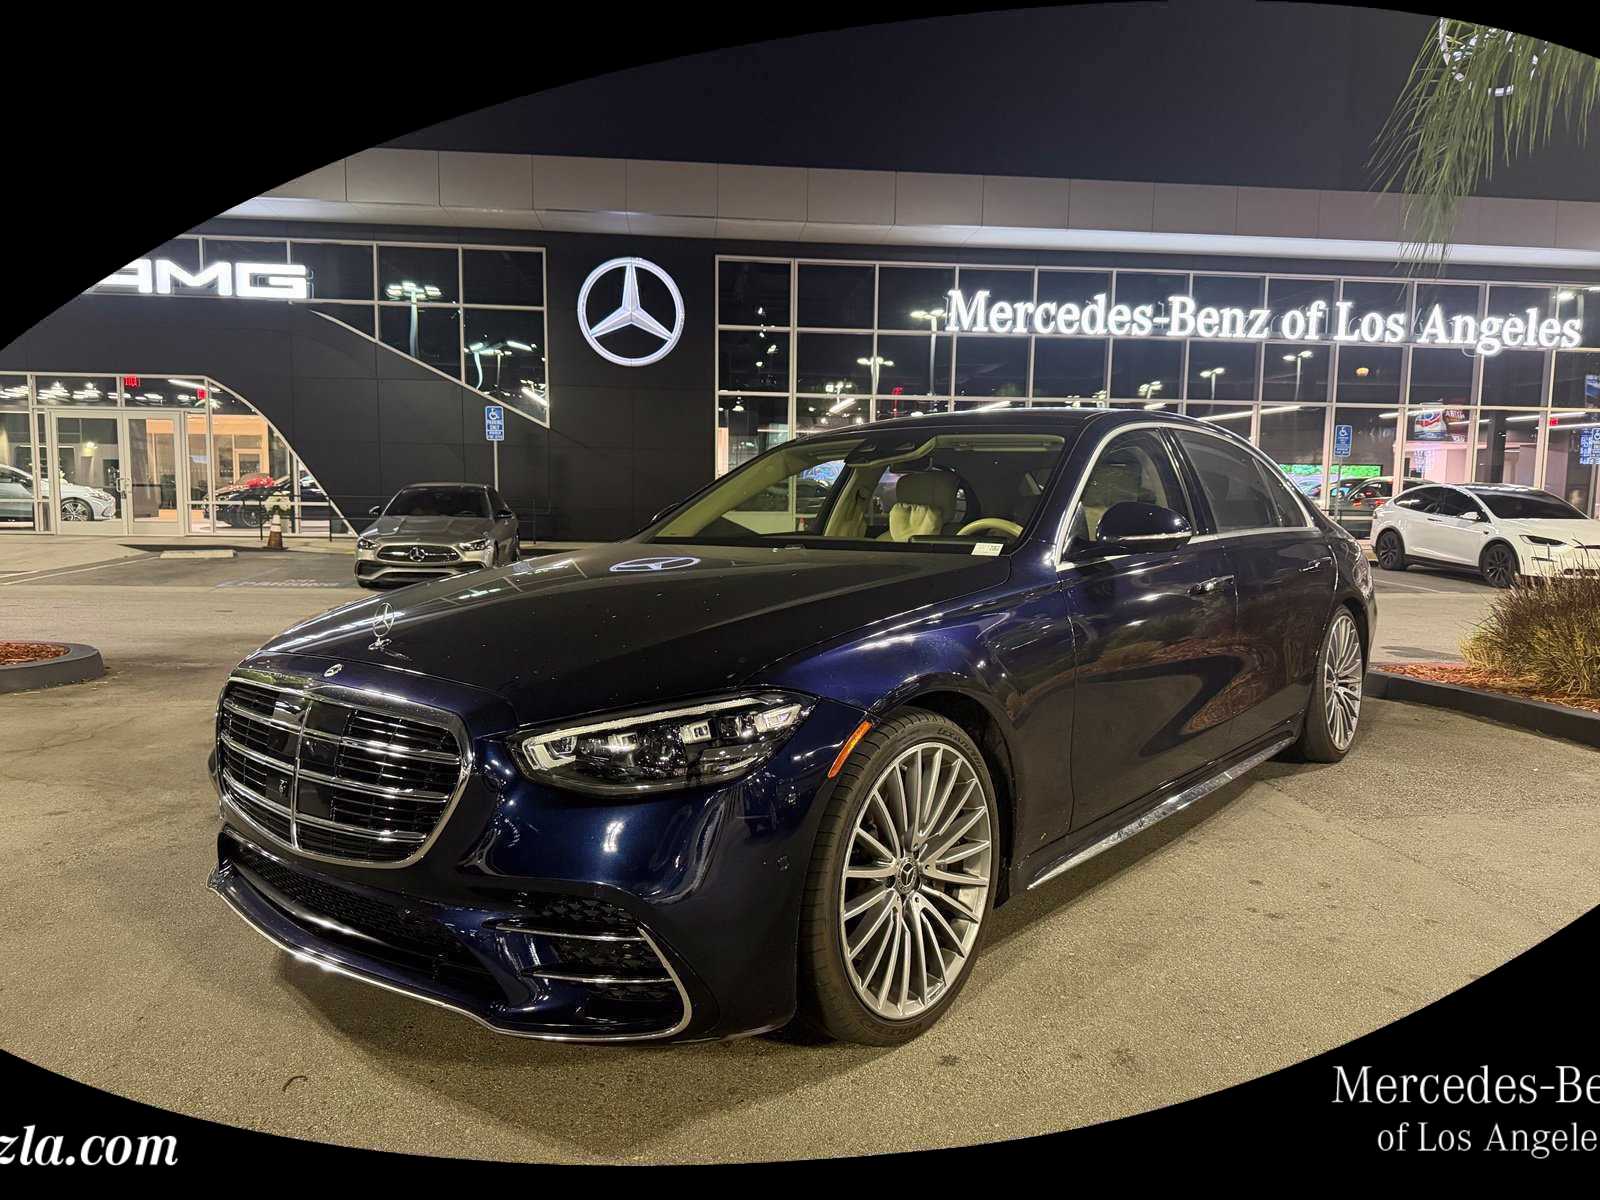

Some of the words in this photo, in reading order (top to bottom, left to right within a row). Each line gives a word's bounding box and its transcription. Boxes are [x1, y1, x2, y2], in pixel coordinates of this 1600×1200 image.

[98, 259, 308, 299] AMG
[945, 289, 1271, 338] Mercedes-Benz
[1281, 301, 1327, 340] of
[1333, 301, 1407, 343] Los
[1417, 304, 1584, 356] Angeles
